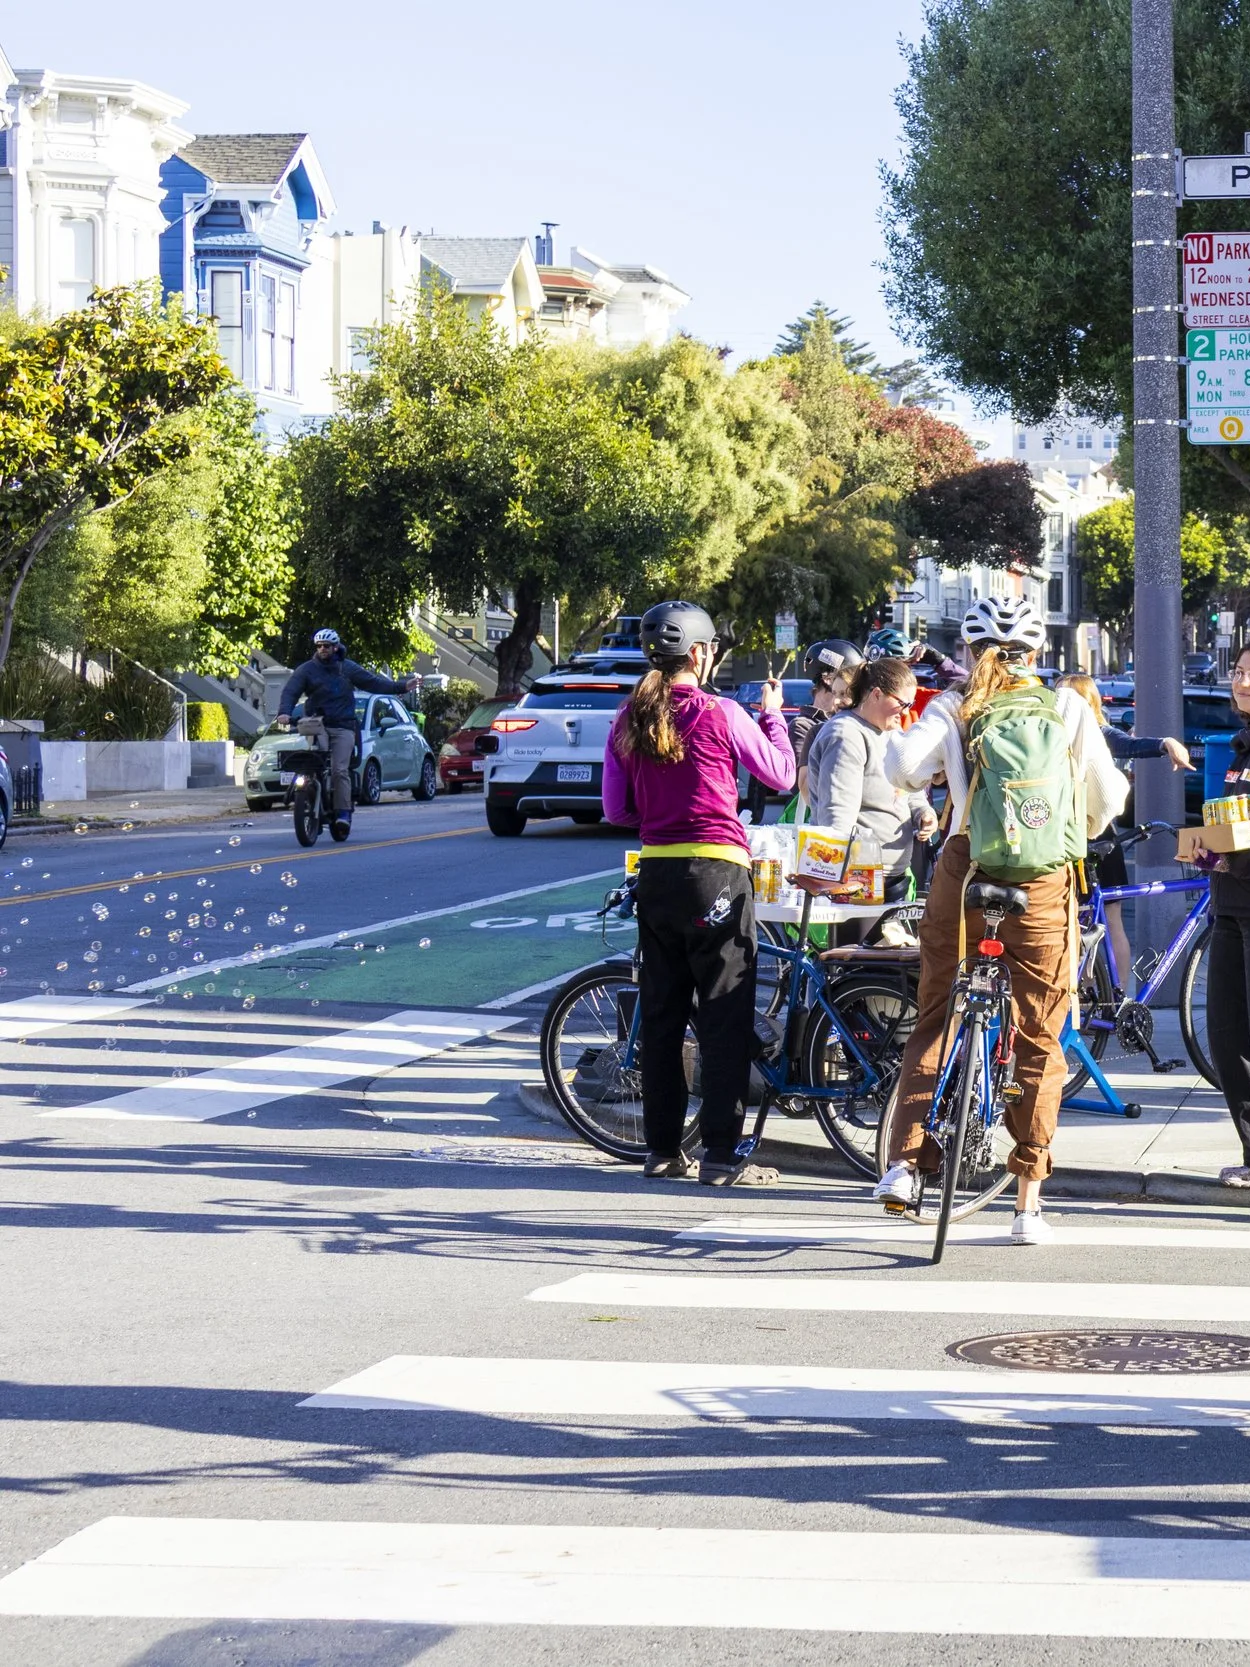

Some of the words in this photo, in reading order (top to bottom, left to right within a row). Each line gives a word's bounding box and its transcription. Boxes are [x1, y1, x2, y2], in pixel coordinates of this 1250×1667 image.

[1187, 237, 1210, 261] NO
[1192, 314, 1224, 324] STREET
[1193, 334, 1210, 358] 2
[1196, 390, 1222, 402] MON
[1196, 409, 1219, 417] EXCEPT
[1193, 426, 1209, 434] AREA
[1223, 420, 1239, 439] Q
[526, 749, 543, 757] today
[810, 867, 825, 875] Mixed
[824, 869, 836, 877] Fruit
